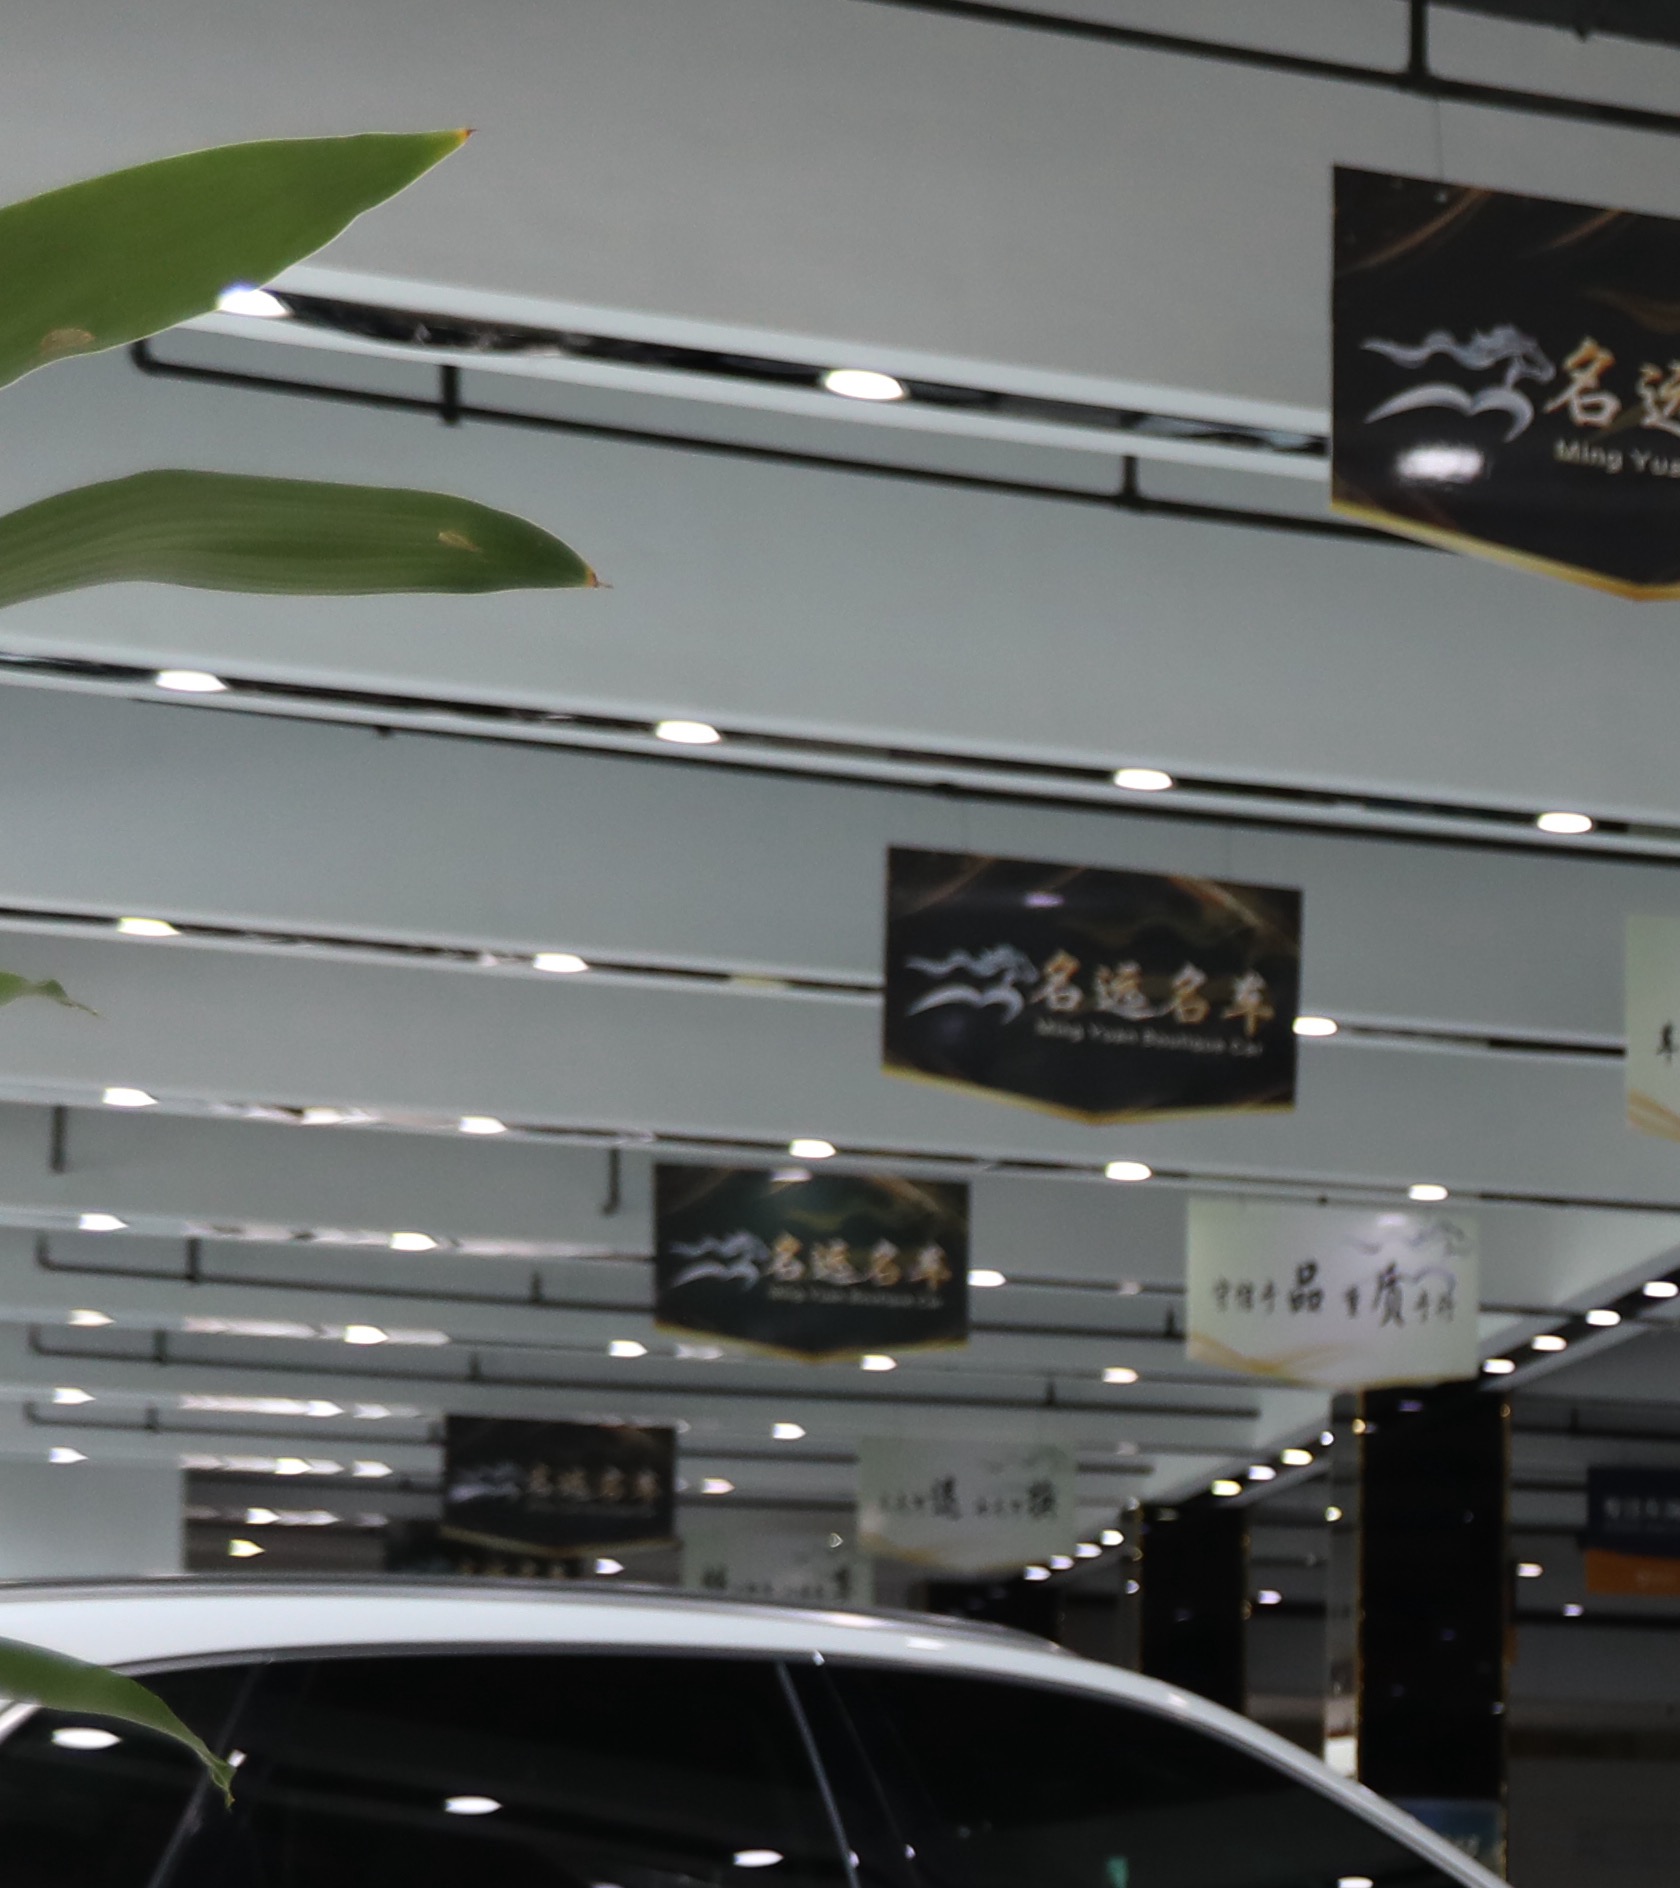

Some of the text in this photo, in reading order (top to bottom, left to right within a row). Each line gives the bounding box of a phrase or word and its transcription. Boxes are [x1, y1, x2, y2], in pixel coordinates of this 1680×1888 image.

[1553, 437, 1624, 474] Ming
[1027, 949, 1275, 1037] 名远名车
